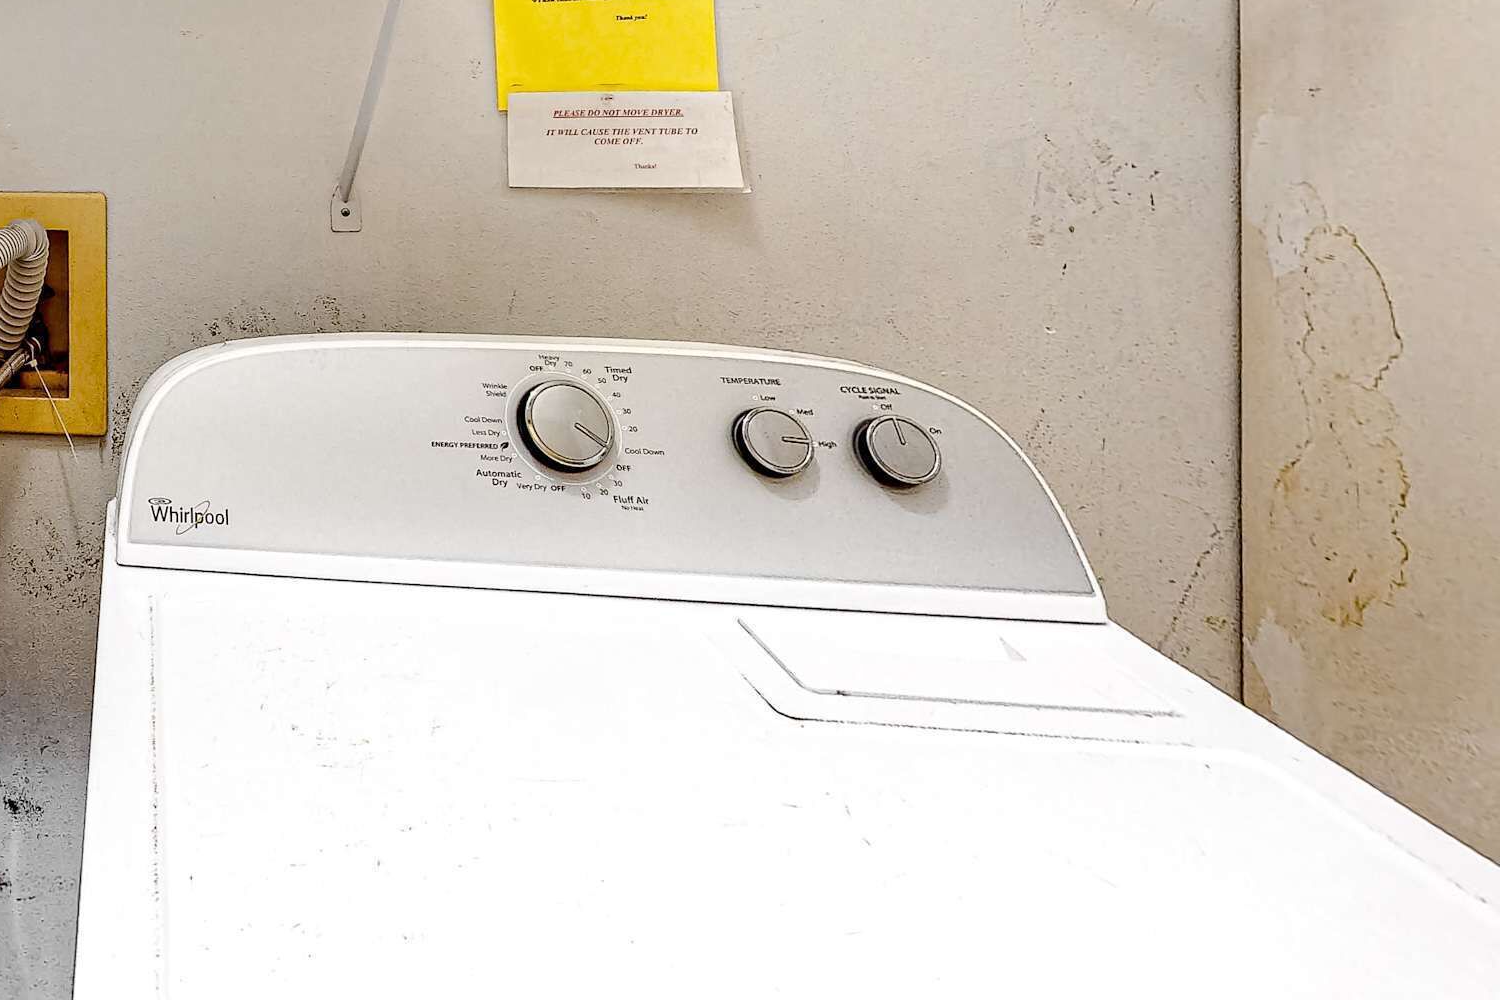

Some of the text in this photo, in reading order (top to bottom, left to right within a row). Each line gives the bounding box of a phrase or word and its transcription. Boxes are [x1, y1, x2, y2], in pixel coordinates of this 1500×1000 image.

[613, 374, 628, 383] Dry
[720, 377, 781, 386] TEMPERATURE
[868, 387, 900, 395] SIGNAL
[488, 429, 500, 438] Dry
[499, 455, 513, 463] Dry
[476, 469, 522, 478] Automatic
[492, 478, 508, 487] Dry
[516, 483, 547, 492] Very Dry
[151, 505, 228, 528] Whirlpool
